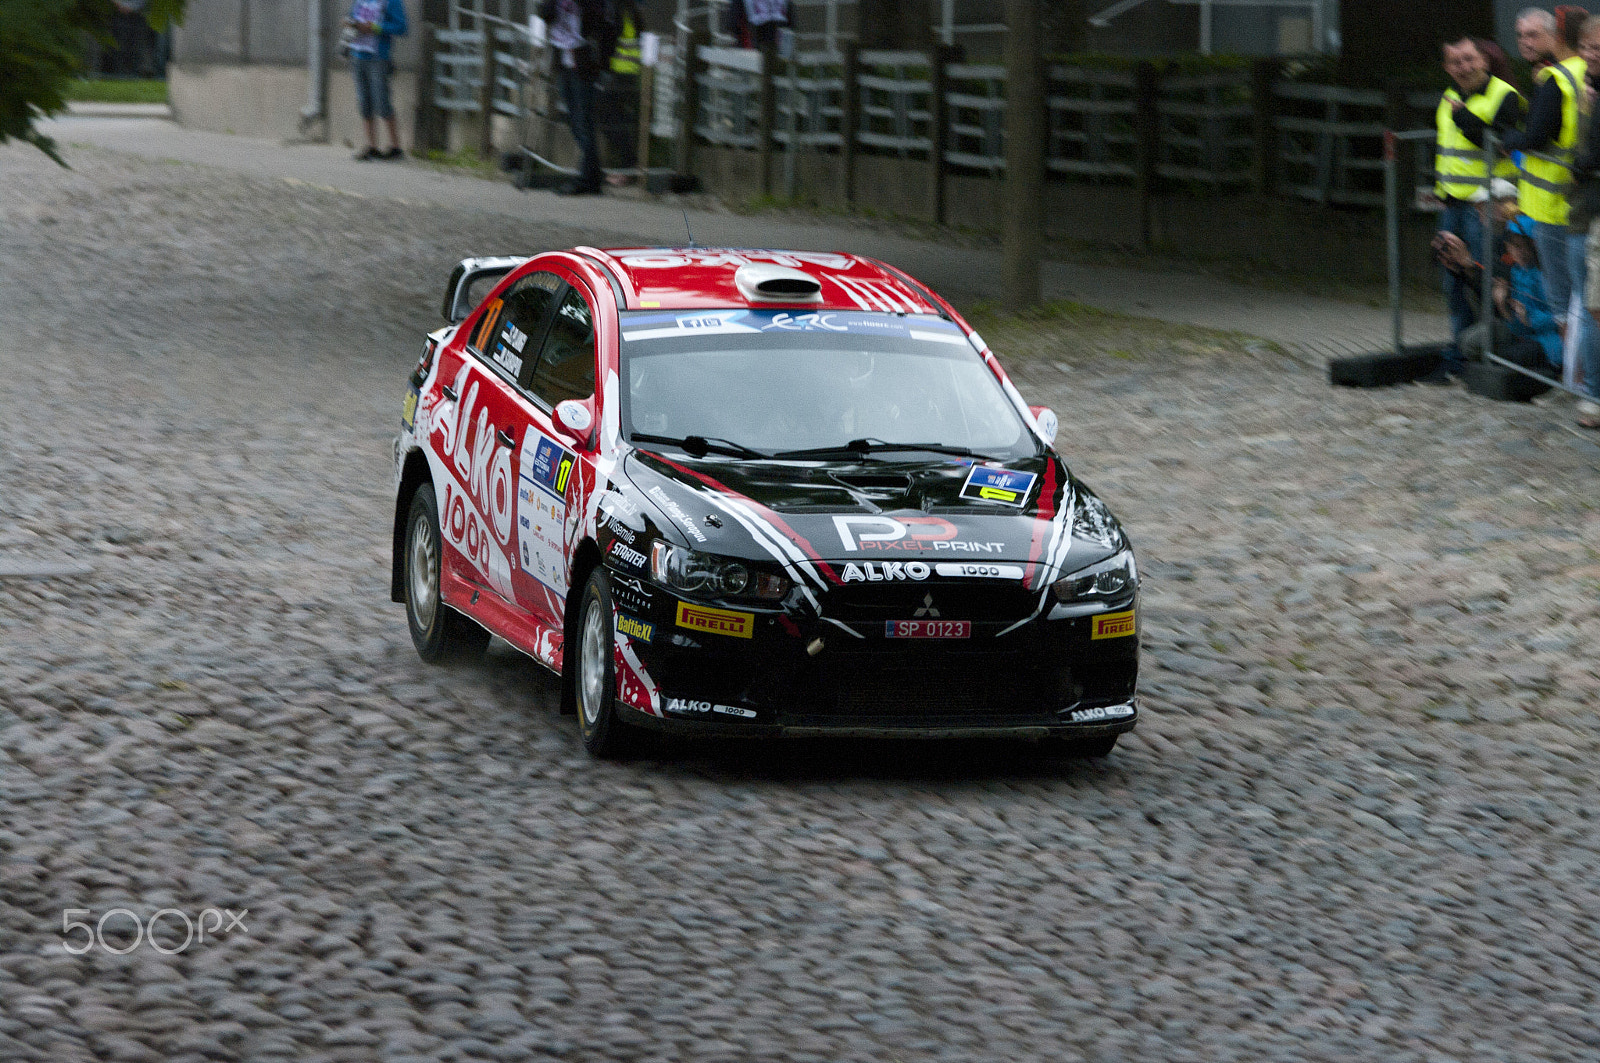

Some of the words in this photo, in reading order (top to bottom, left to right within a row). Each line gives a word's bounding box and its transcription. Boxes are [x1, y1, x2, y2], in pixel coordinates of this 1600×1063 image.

[430, 361, 514, 547] ALKO
[442, 482, 490, 578] 1000
[607, 514, 636, 545] Wisemile
[611, 541, 648, 568] STARTER
[841, 561, 931, 582] ALKO
[960, 565, 1000, 577] 1000
[617, 614, 652, 642] BalticXL
[681, 607, 746, 633] PIRELLI
[898, 622, 920, 637] SP
[926, 622, 964, 637] 0123
[668, 698, 711, 713] ALKO
[725, 706, 745, 715] 1000
[1070, 707, 1106, 722] ALKO
